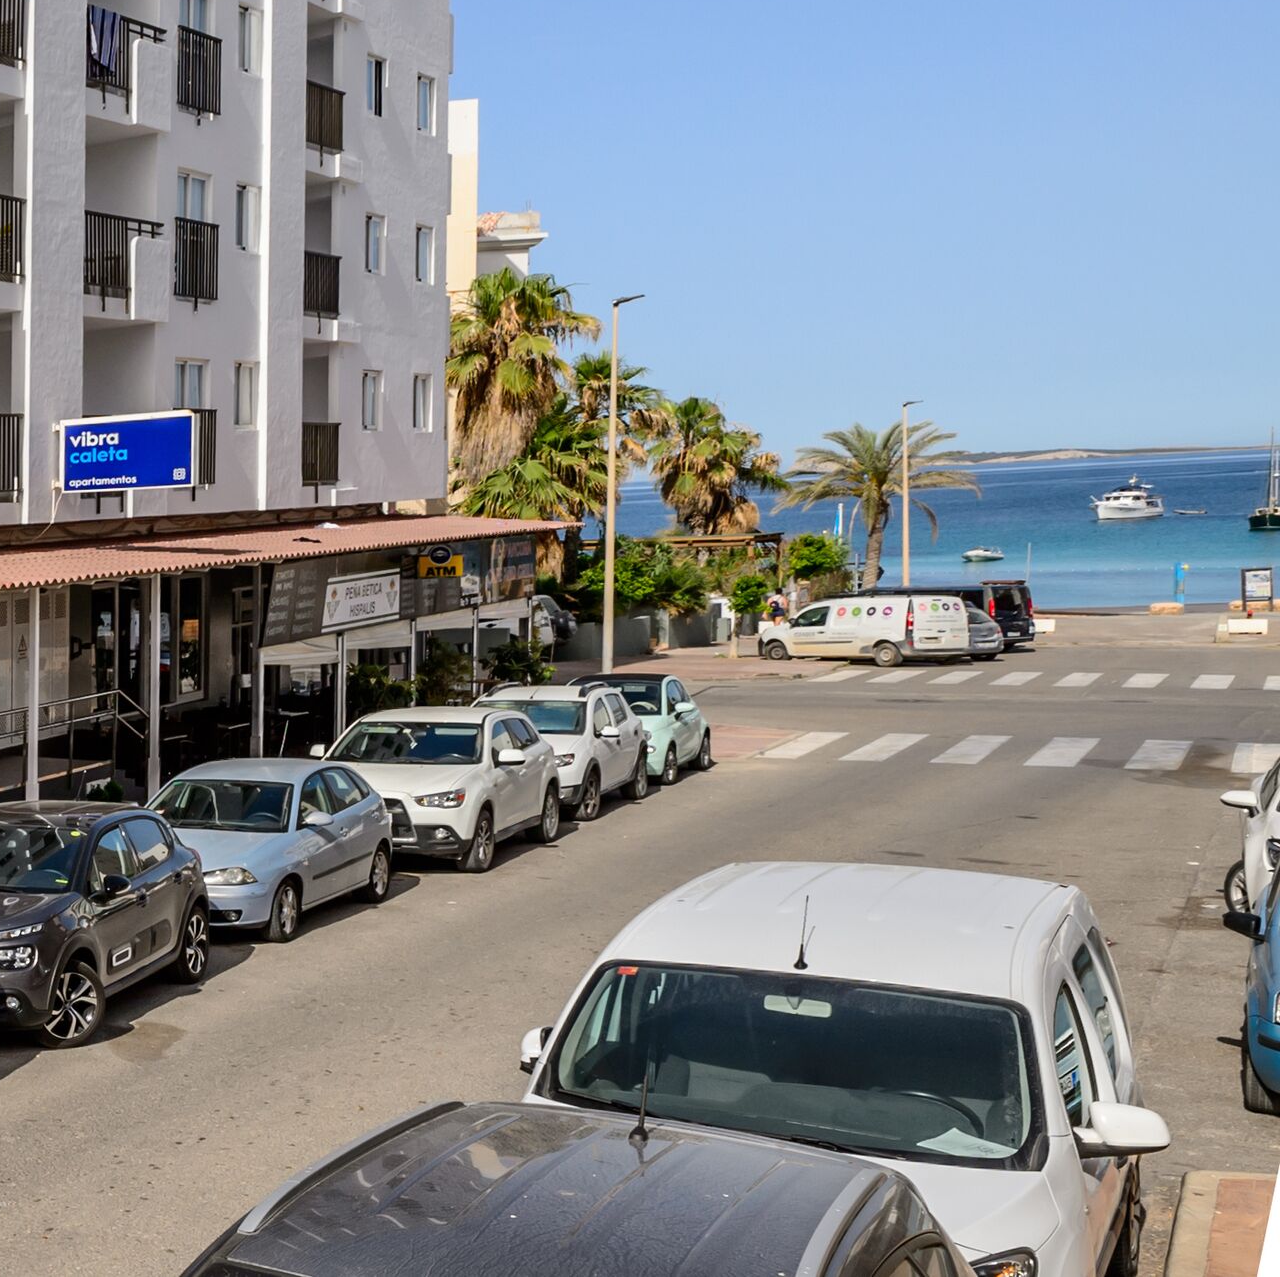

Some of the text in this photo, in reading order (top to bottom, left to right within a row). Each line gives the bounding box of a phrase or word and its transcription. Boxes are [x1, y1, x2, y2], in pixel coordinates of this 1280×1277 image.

[69, 431, 120, 447] vibra
[69, 446, 128, 464] caleta
[68, 475, 138, 488] apartamentos
[425, 566, 457, 577] ATM
[344, 584, 361, 600] PEÑA
